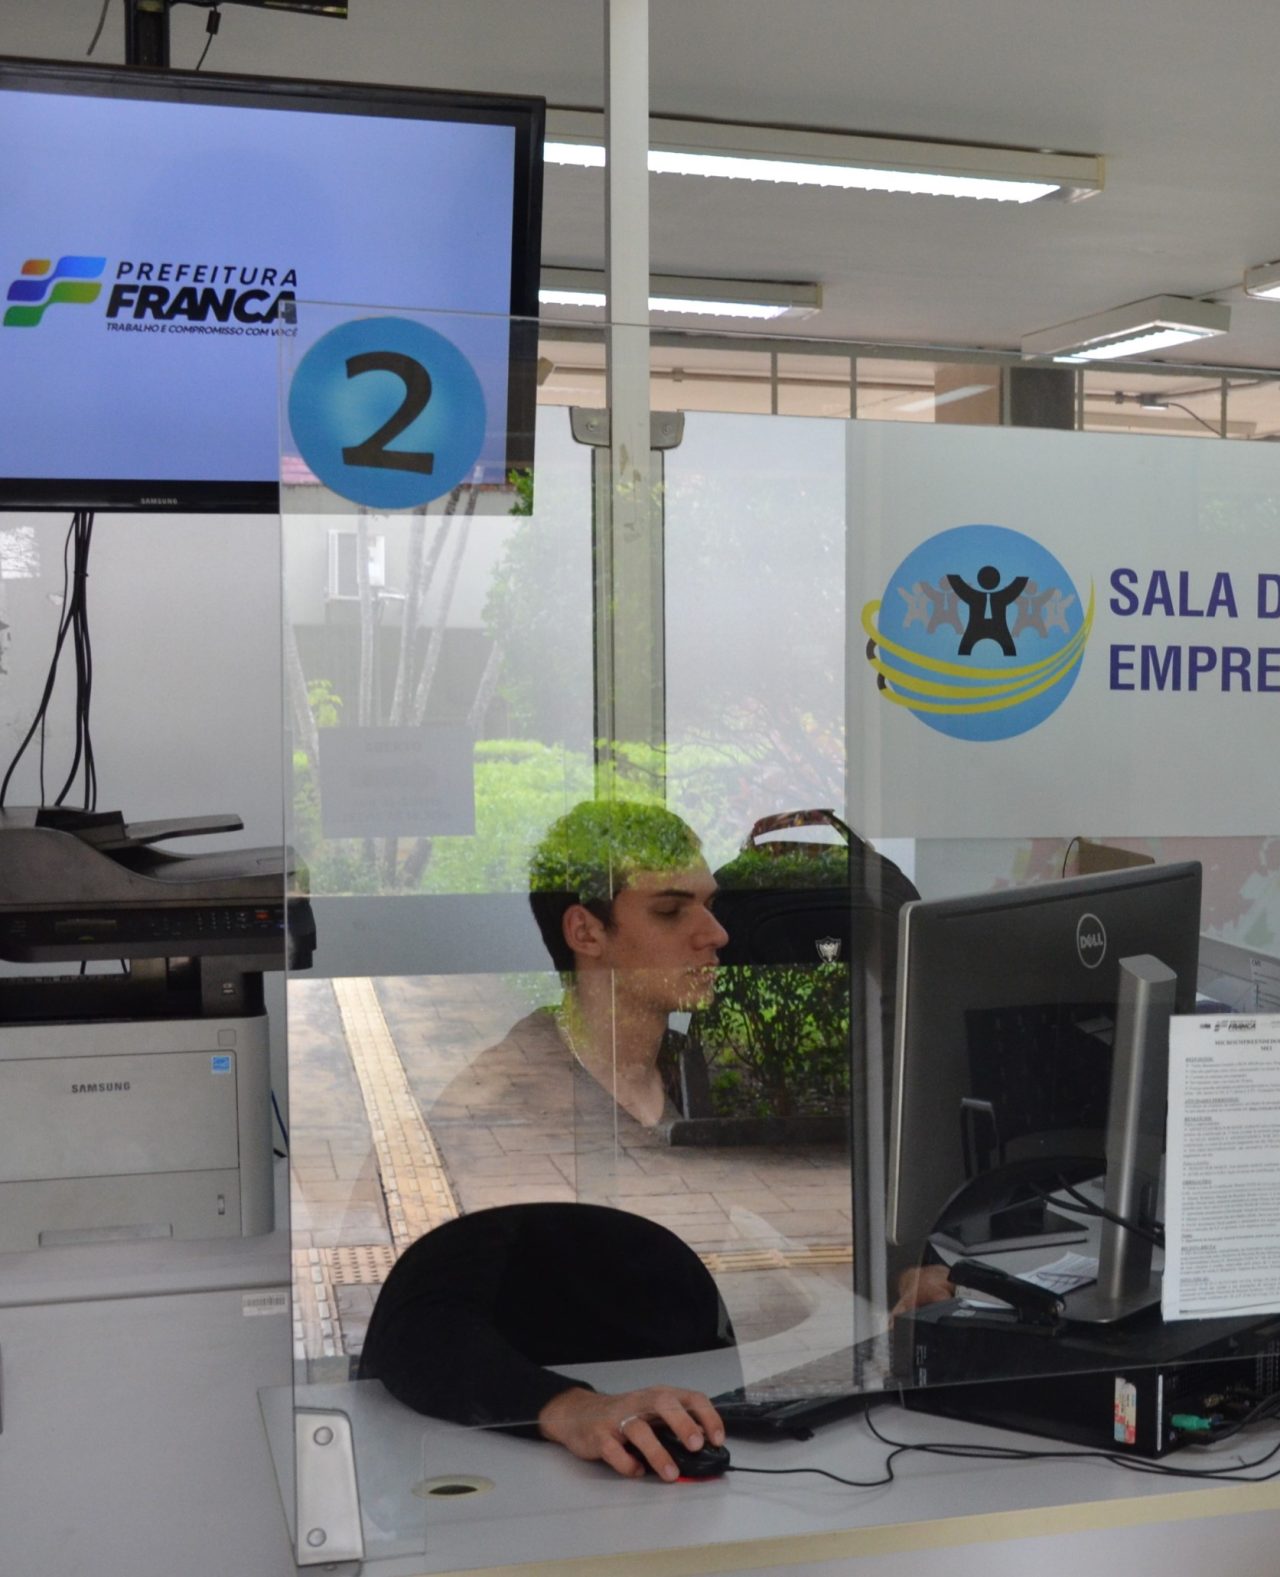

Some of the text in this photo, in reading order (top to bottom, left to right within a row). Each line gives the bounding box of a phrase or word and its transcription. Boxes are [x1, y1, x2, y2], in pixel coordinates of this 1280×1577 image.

[116, 261, 297, 287] PREFEITURA
[106, 284, 297, 324] FRANCA
[106, 322, 160, 333] TRABALHO
[160, 324, 167, 333] E
[168, 324, 244, 336] COMPROMISSO
[245, 327, 269, 336] COM
[341, 351, 435, 475] 2
[140, 497, 178, 505] SAMSUNG
[1109, 567, 1239, 618] SALA
[1079, 932, 1104, 949] DELL
